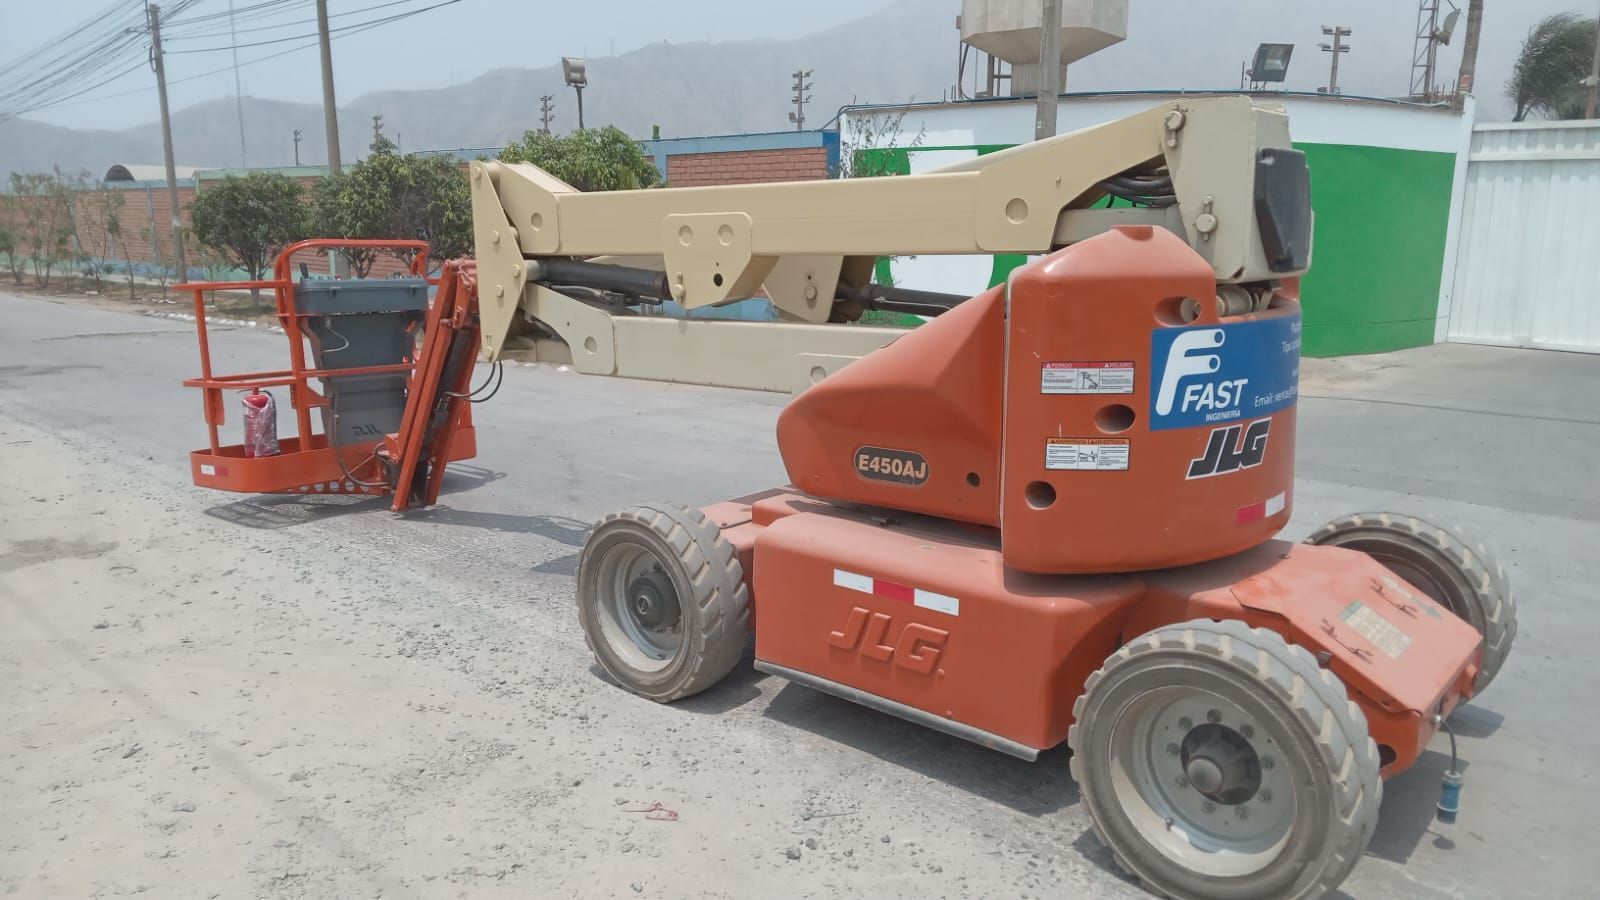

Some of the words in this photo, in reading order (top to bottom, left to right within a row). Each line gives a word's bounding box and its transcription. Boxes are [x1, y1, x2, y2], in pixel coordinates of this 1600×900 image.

[1181, 378, 1249, 412] FAST
[1205, 408, 1241, 422] INGENIERÍA
[1185, 416, 1272, 480] JLG
[858, 454, 927, 479] E450AJ
[828, 606, 950, 676] JLG
